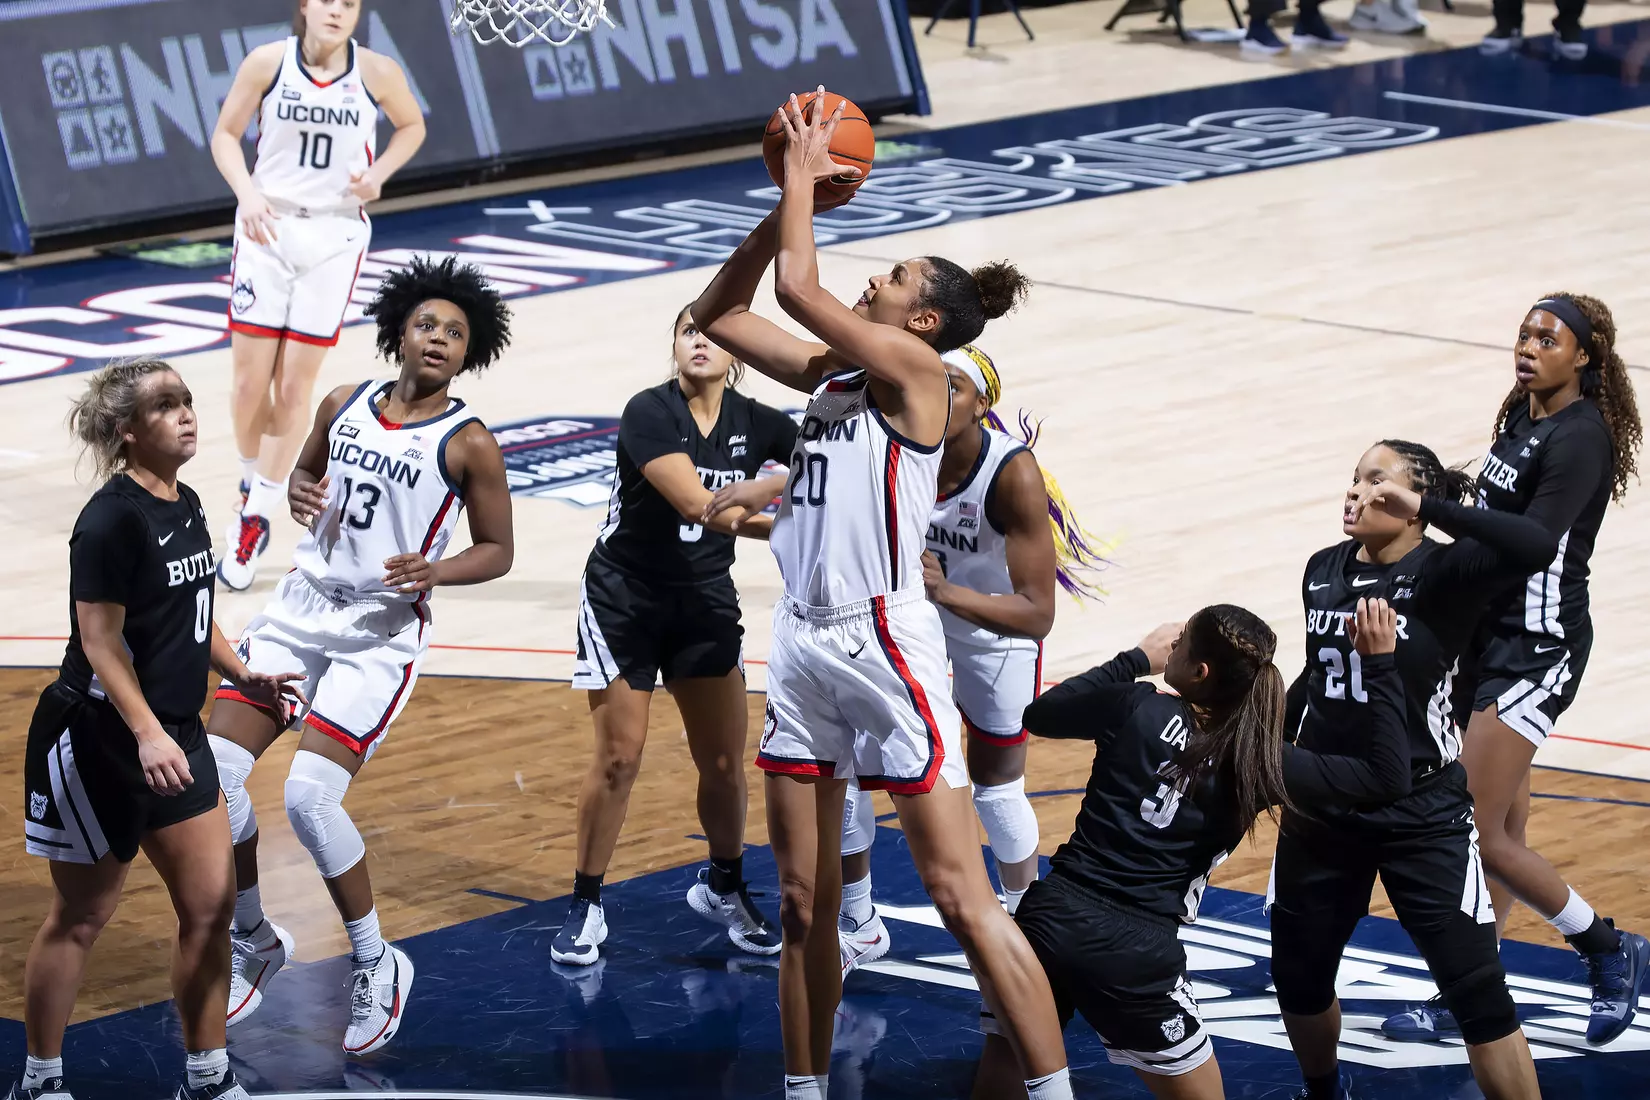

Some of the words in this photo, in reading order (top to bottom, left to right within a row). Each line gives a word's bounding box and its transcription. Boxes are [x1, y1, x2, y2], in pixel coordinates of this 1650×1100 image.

[120, 10, 431, 158] NHA
[277, 101, 360, 127] UCONN
[299, 130, 333, 169] 10
[330, 439, 421, 489] UCONN
[790, 451, 829, 508] 20
[339, 476, 382, 530] 13
[194, 587, 210, 643] 0
[1307, 608, 1410, 640] BUTR
